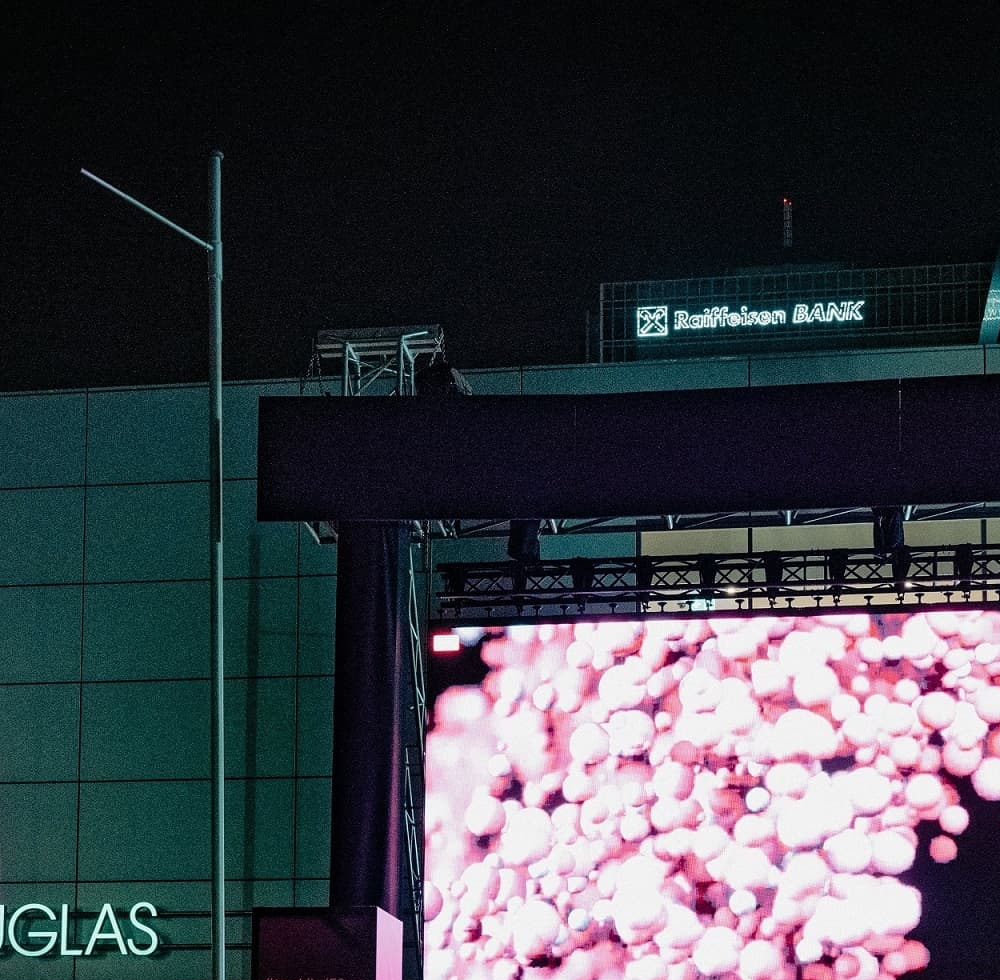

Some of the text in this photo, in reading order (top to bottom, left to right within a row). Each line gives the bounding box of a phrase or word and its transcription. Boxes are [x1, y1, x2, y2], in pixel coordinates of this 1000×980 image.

[674, 301, 865, 329] Raiffeisen BANK
[0, 902, 158, 957] GLAS
